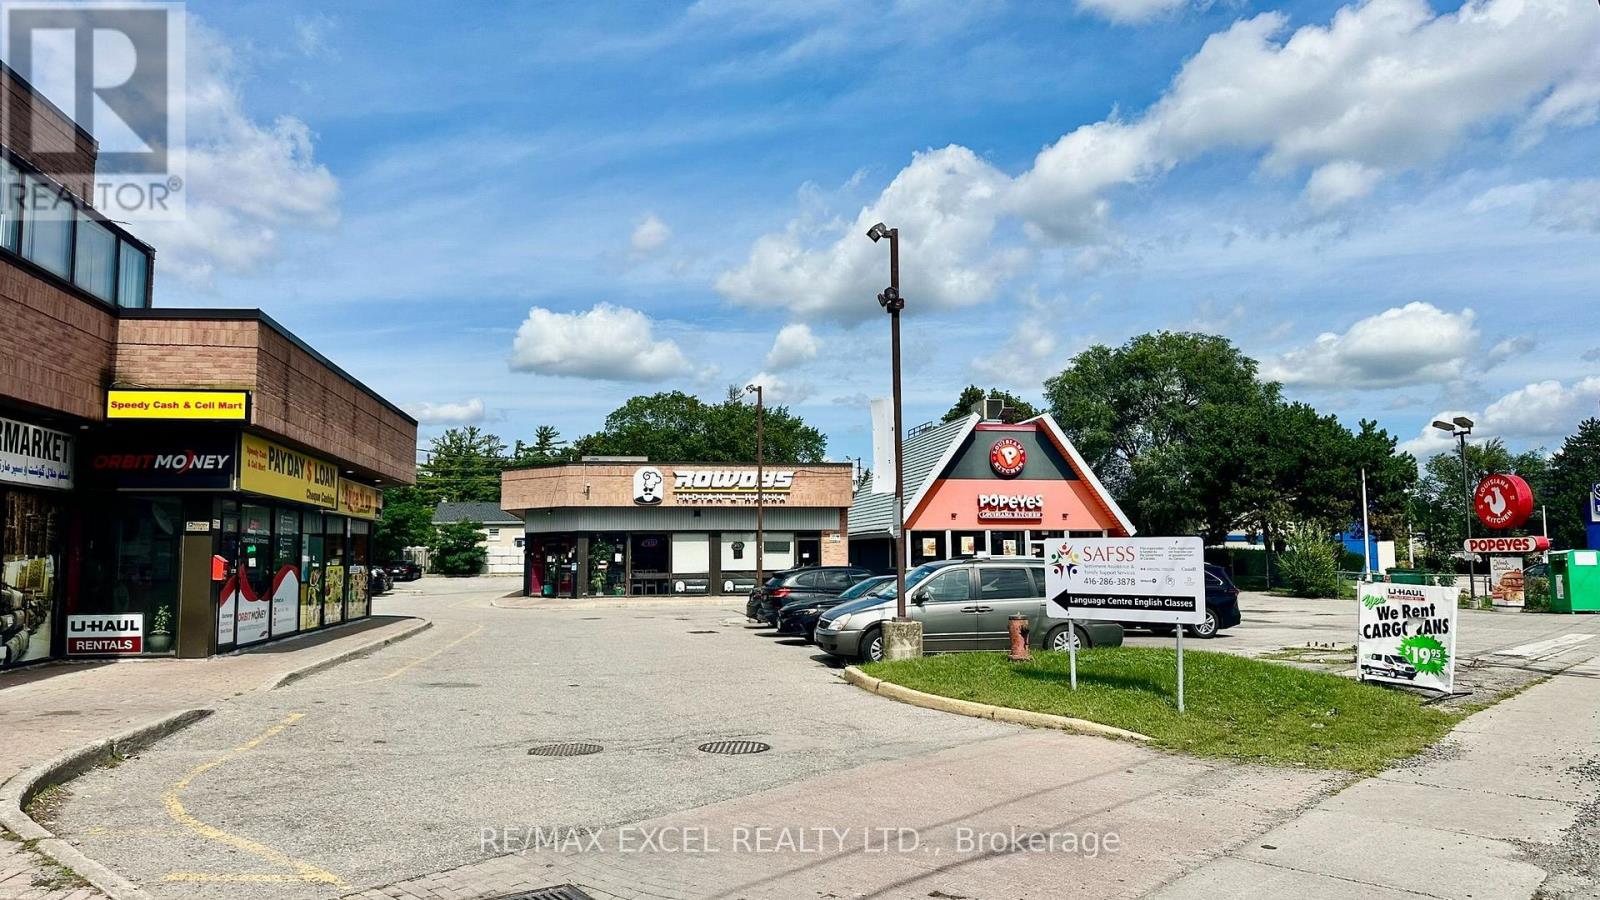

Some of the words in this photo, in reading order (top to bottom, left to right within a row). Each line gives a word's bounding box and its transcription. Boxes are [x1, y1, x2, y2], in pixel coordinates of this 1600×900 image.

[111, 401, 150, 410] Speedy
[153, 401, 180, 409] Cash
[183, 401, 191, 409] &
[992, 439, 1025, 454] LOUISIANA
[268, 446, 306, 480] PAYDAY
[306, 458, 312, 484] $
[314, 462, 336, 489] LOAN
[993, 462, 1024, 474] KITCHEN
[1479, 478, 1509, 497] LOUISIANA
[676, 493, 722, 502] INDIAN
[1486, 509, 1513, 524] KITCHEN
[1083, 546, 1135, 562] SAFSS
[1083, 577, 1136, 586] 416-286-3878
[1388, 588, 1424, 597] U-HAUL
[1070, 596, 1106, 605] Language
[1107, 597, 1133, 605] Centre
[1134, 598, 1163, 607] English
[1164, 599, 1193, 608] Classes
[1376, 605, 1399, 621] We
[1402, 603, 1436, 619] Rent
[70, 619, 140, 632] U-HAUL
[76, 639, 133, 650] RENTALS
